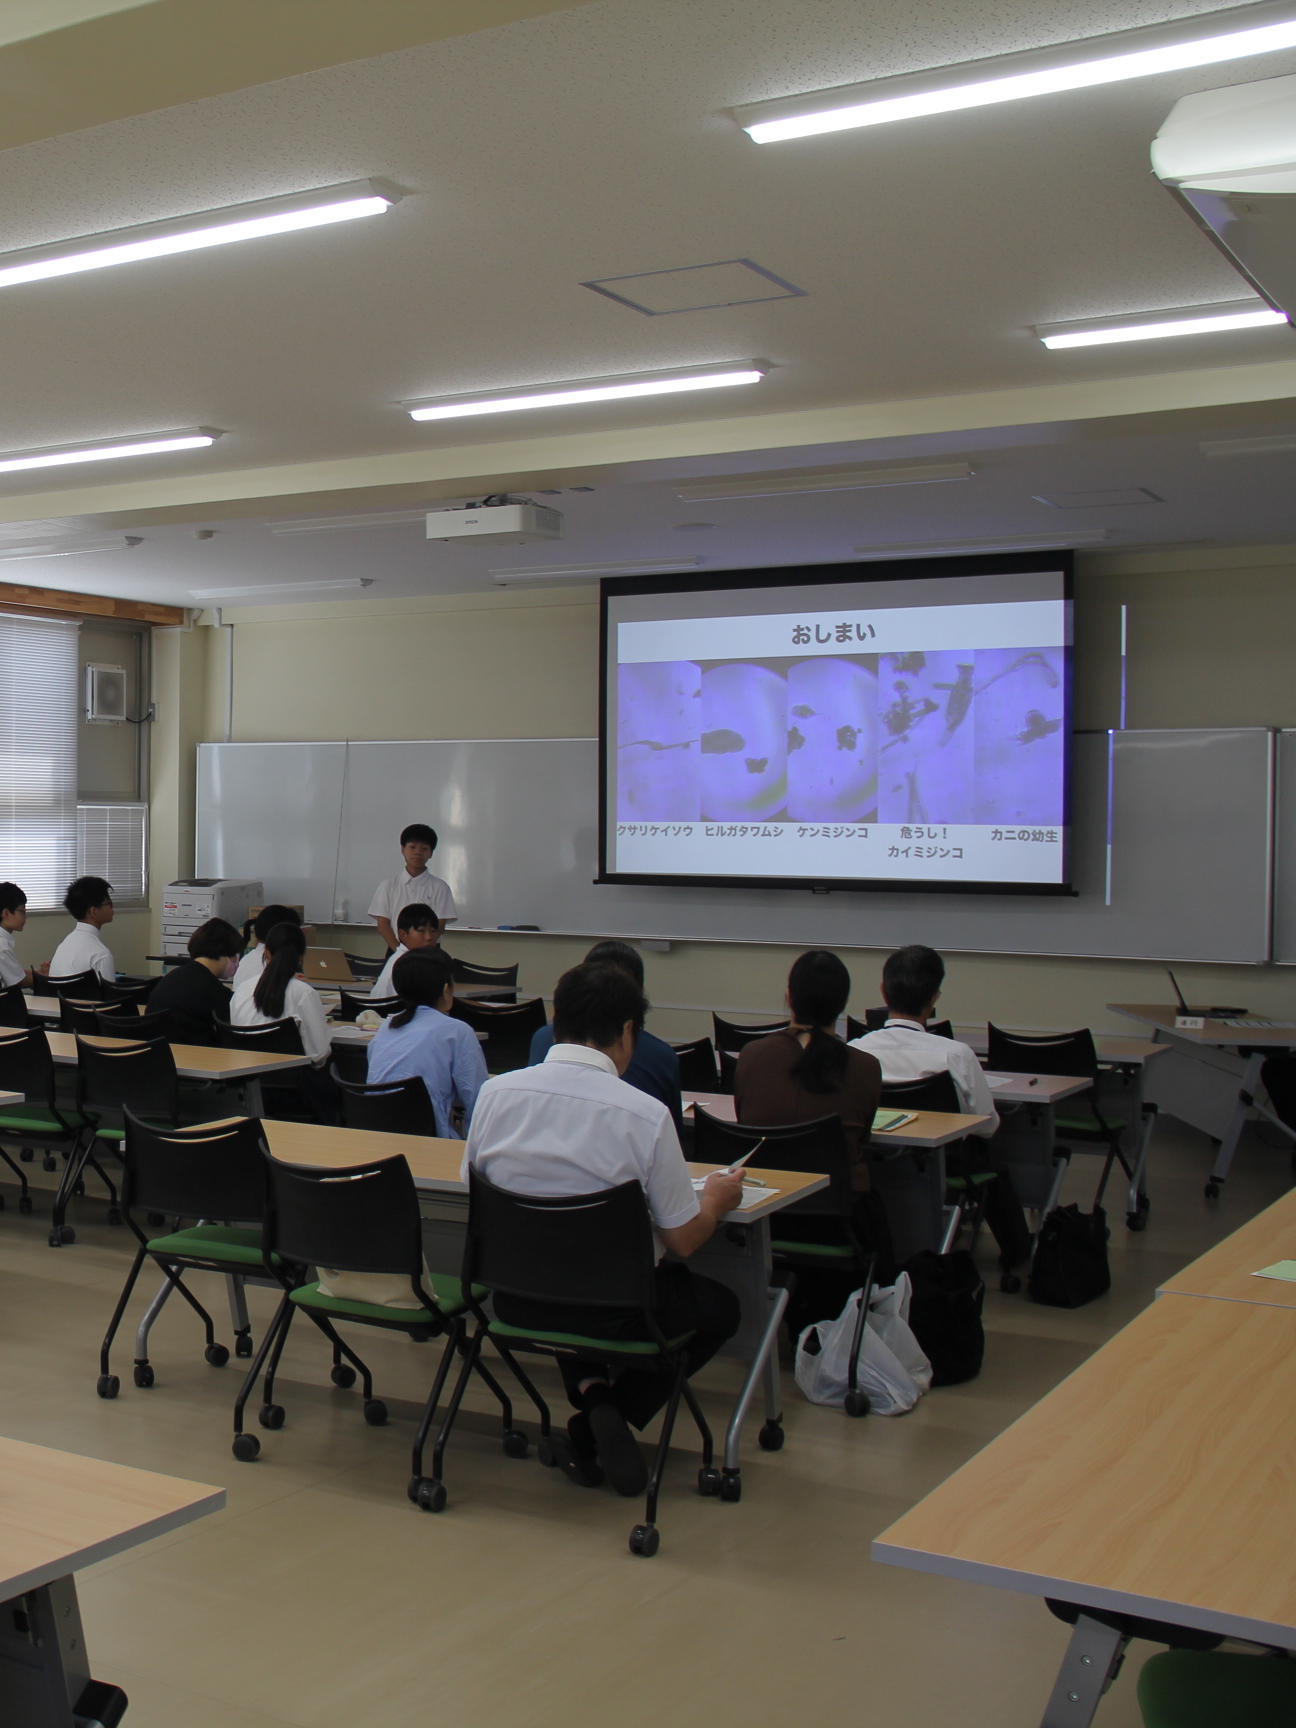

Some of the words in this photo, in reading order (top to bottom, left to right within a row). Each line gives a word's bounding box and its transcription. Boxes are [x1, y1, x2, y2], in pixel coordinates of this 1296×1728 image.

[791, 622, 876, 645] おしまい
[616, 825, 694, 837] クサリケイソウ
[704, 825, 784, 838] ヒルガタワムシ
[797, 826, 869, 839] ケンミジンコ
[900, 826, 947, 839] 危うし！
[991, 829, 1059, 842] カニの幼生
[888, 846, 963, 859] カイミジンコ
